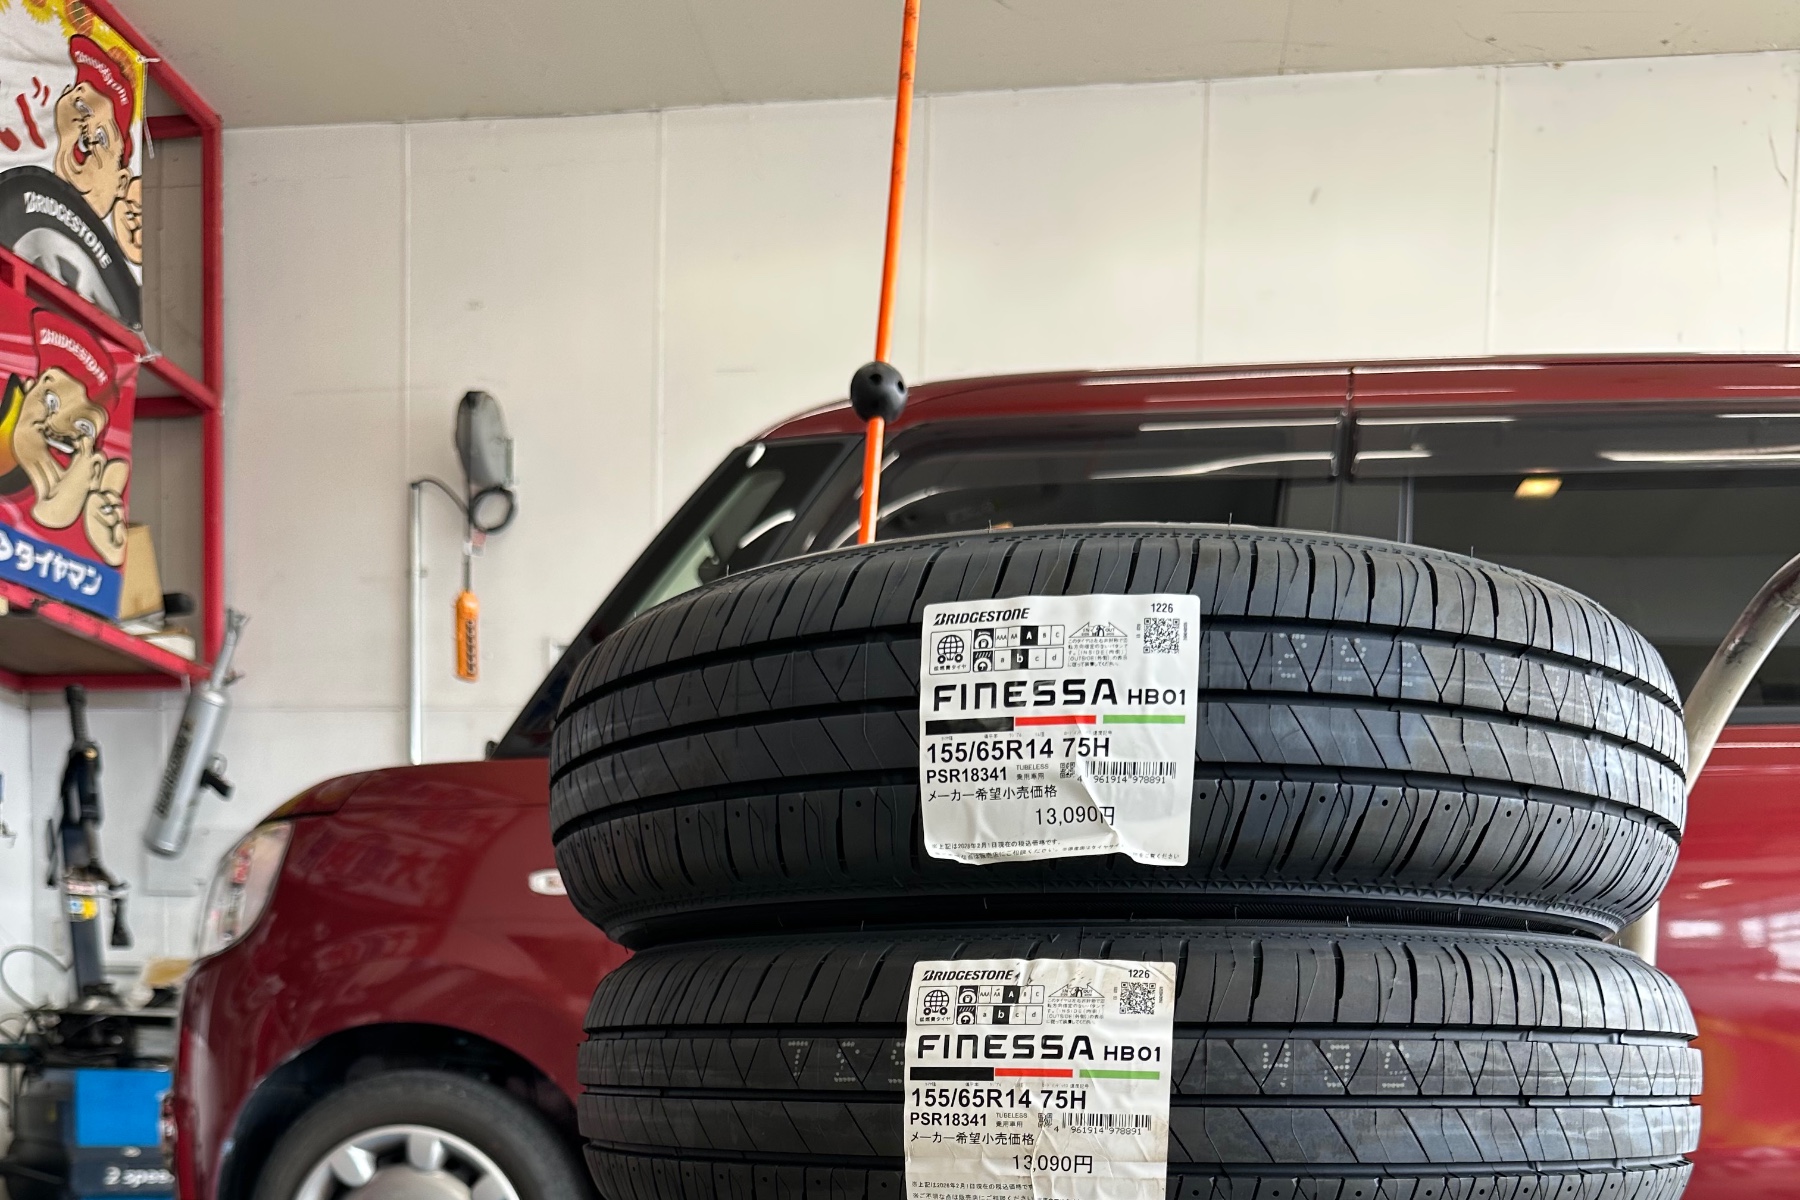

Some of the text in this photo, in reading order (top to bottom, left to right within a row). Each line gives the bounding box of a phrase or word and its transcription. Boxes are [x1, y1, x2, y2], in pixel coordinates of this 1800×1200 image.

[23, 191, 112, 269] BRIDGESTONE
[933, 608, 1030, 626] BRIDGESTONE
[1151, 603, 1174, 613] 1226
[1026, 631, 1033, 640] A
[934, 678, 1118, 712] FINESSA
[926, 737, 1110, 763] 155/65R14 75H
[926, 766, 1007, 784] PSR18341
[928, 784, 1058, 802] メーカー希望小売価格
[1035, 806, 1115, 826] 13,090円
[922, 970, 1014, 981] BRIDGESTONE
[1128, 969, 1150, 979] 1226
[918, 1034, 1094, 1060] FINESSA
[912, 1088, 1086, 1110] 155/65R14 75H
[910, 1112, 987, 1126] PSR18341
[910, 1131, 1035, 1146] メーカー希望小売価格
[1070, 1126, 1104, 1134] 961914
[1012, 1154, 1093, 1174] 13,090円
